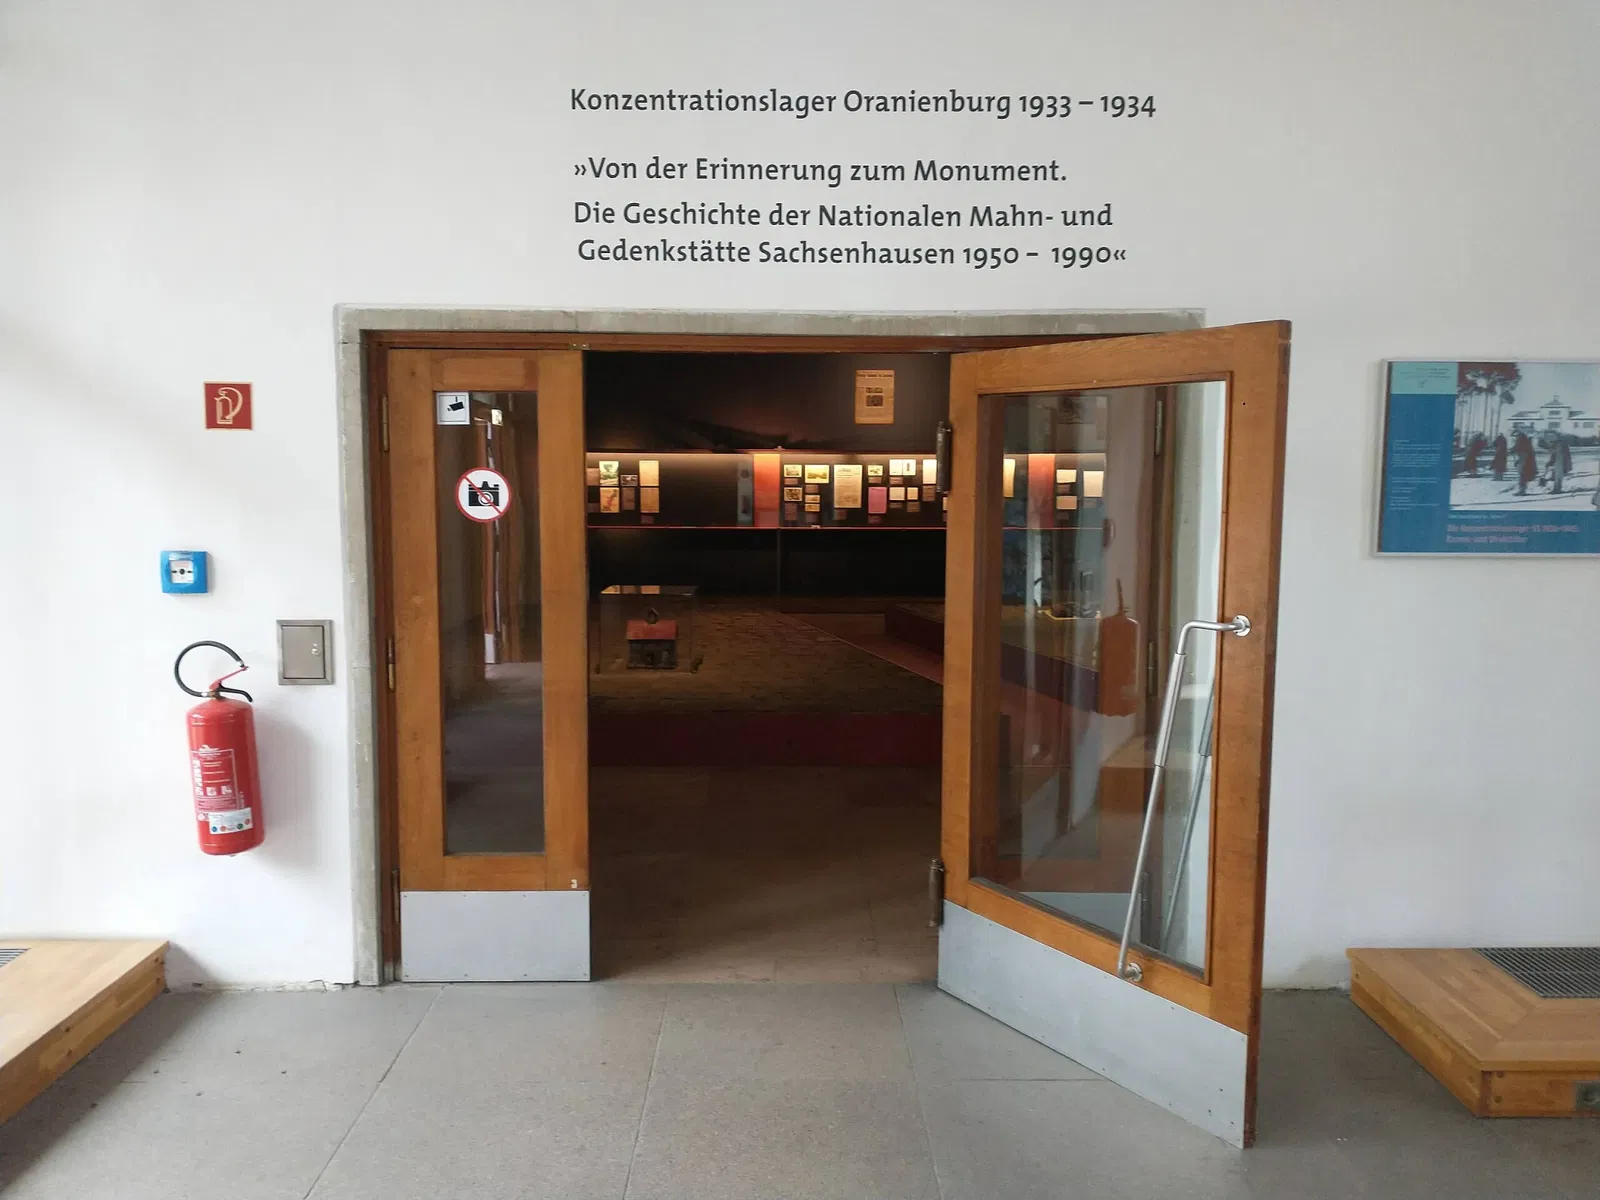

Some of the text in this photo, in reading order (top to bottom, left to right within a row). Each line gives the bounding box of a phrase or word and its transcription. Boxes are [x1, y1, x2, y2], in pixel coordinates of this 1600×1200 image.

[571, 89, 837, 119] Konzentrationslager
[843, 90, 1010, 119] Oranienburg
[1018, 95, 1072, 119] 1933
[1099, 95, 1157, 119] 1934
[573, 155, 1067, 189] »Von der Erinnerung zum Monument.
[574, 200, 1114, 228] Die Geschichte der Nationalen Mahn- und
[577, 237, 751, 263] Gedenkstätte
[758, 240, 955, 265] Sachsenhausen
[962, 247, 1020, 270] 1950
[1051, 246, 1127, 269] 1990«
